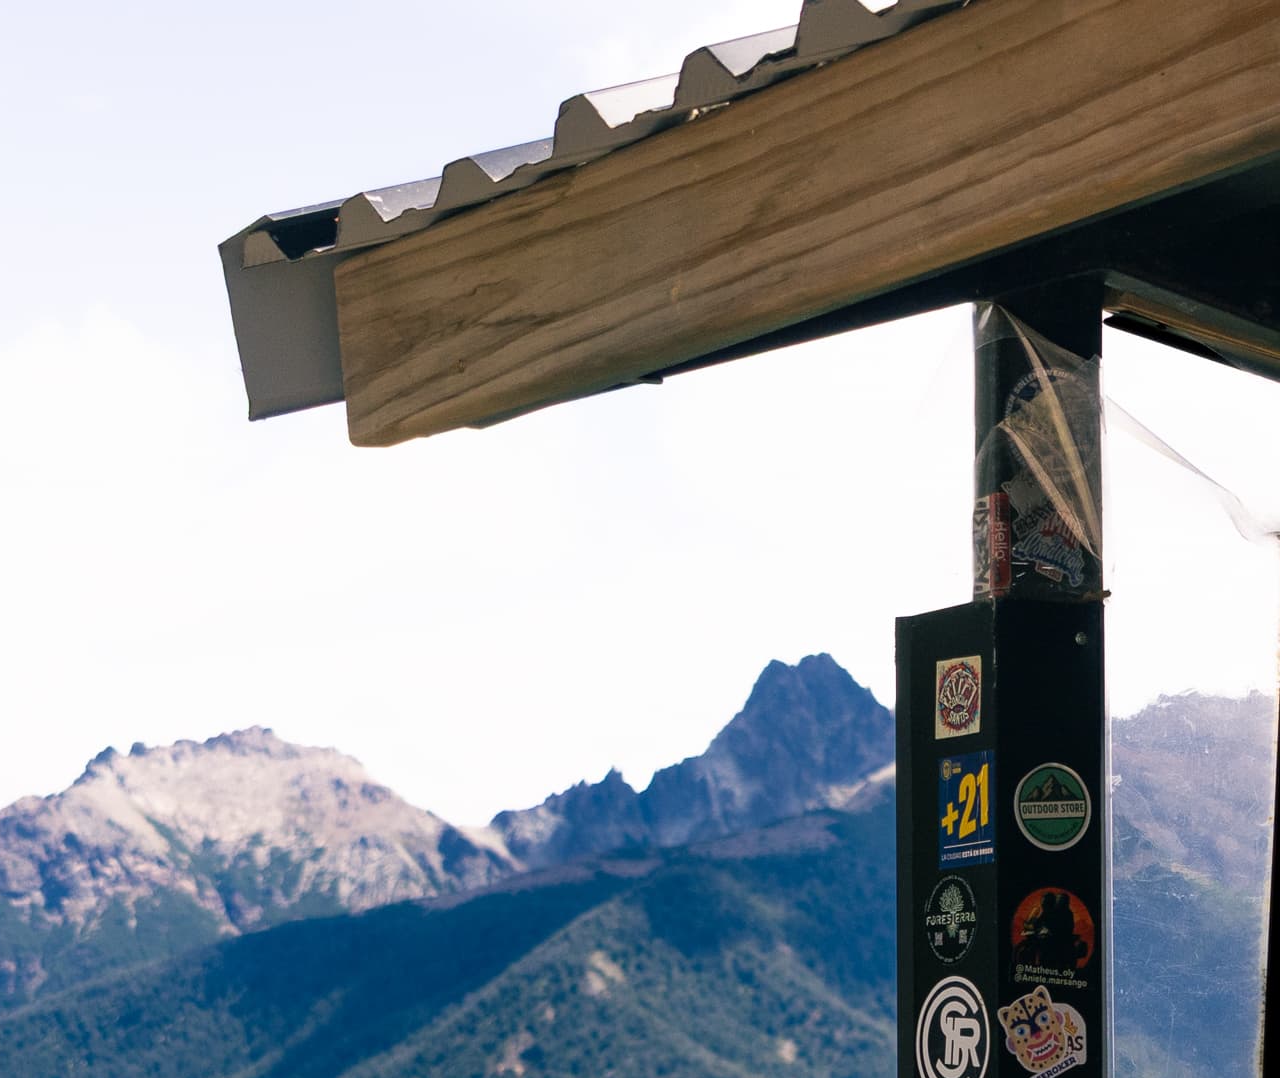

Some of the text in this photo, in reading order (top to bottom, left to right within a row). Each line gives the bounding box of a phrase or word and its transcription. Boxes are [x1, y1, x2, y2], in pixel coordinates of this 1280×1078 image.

[941, 763, 990, 840] +21
[1022, 803, 1084, 814] OUTDOOR STORE
